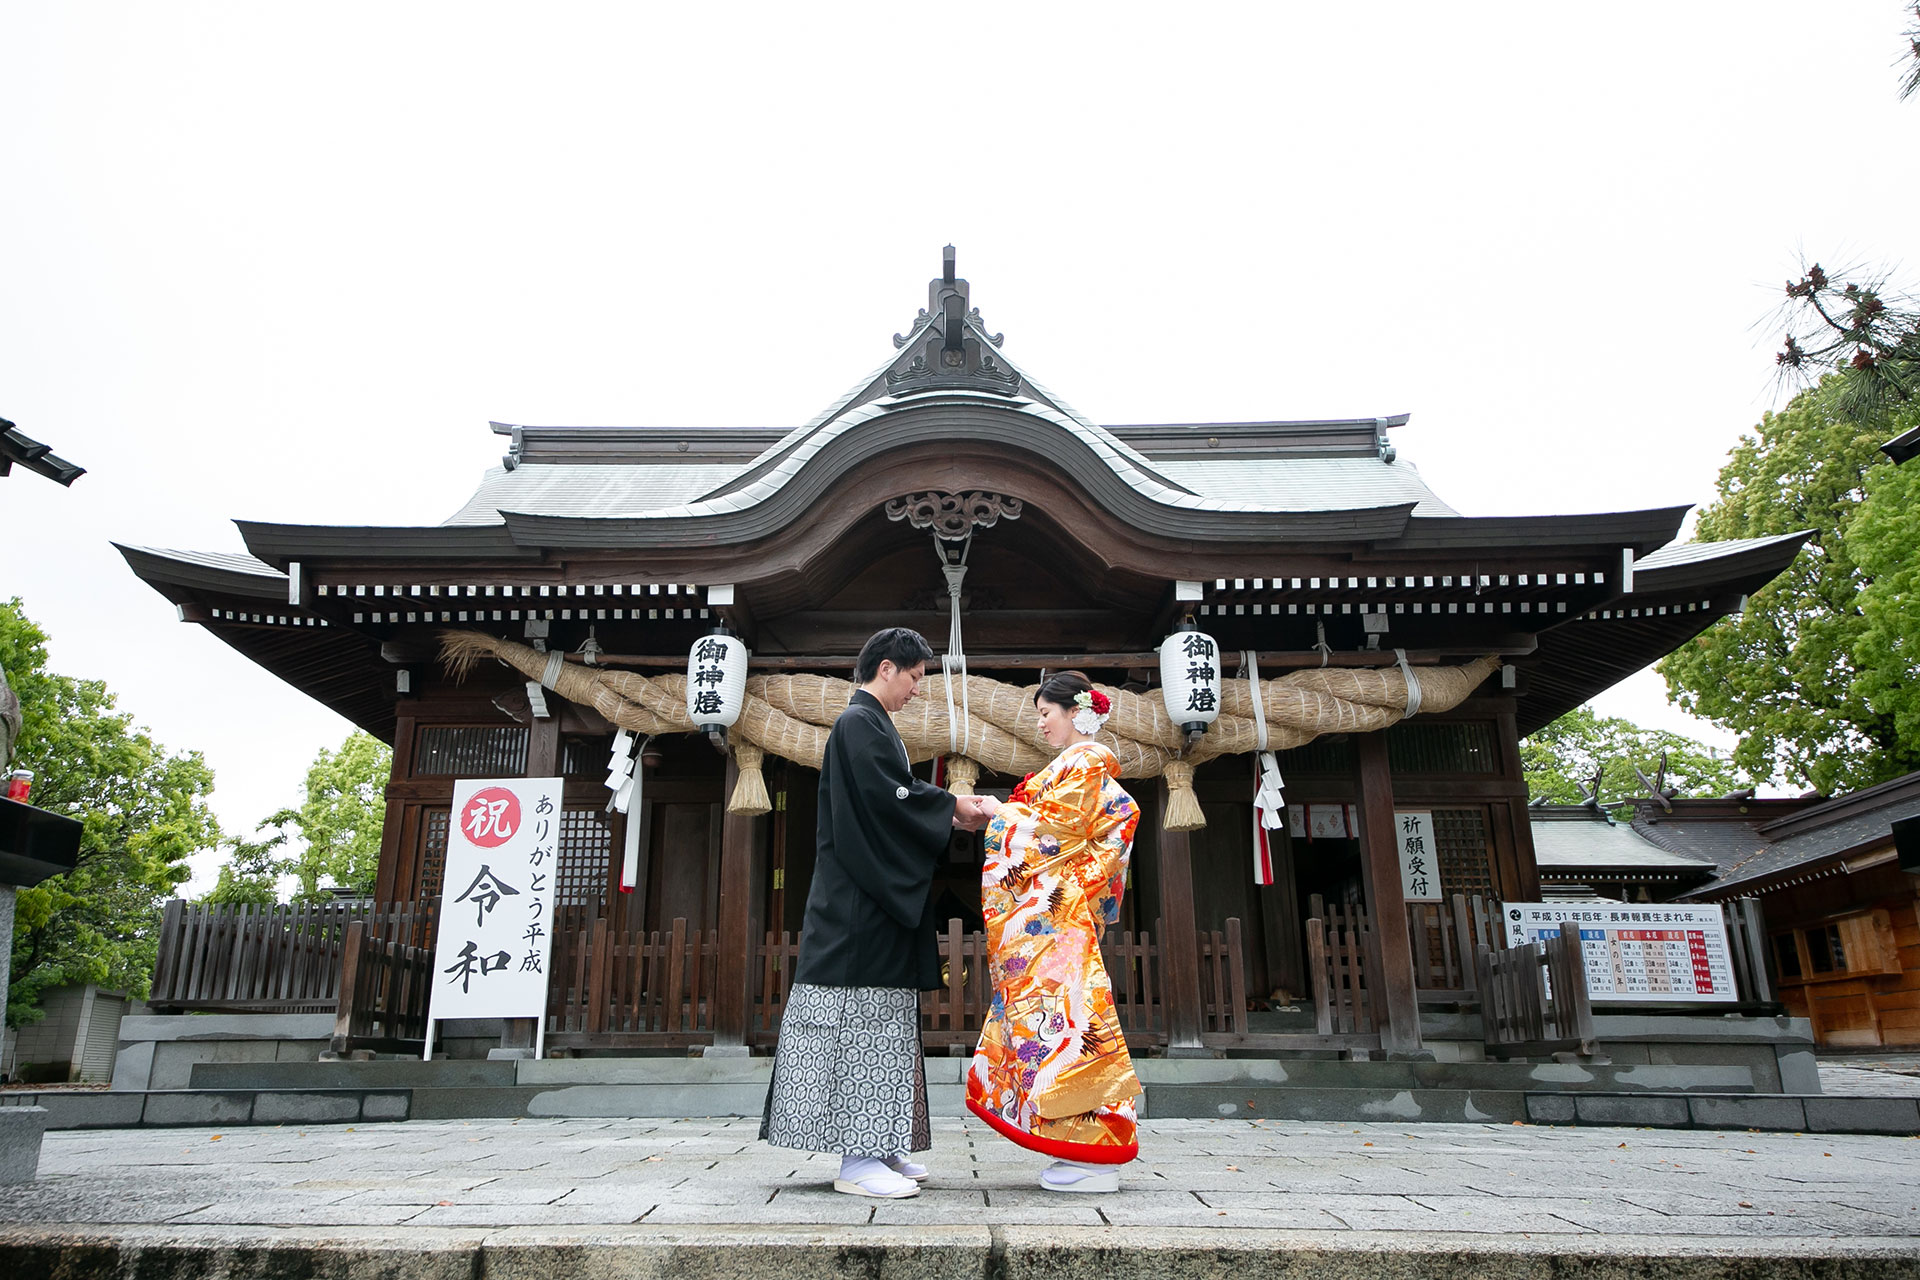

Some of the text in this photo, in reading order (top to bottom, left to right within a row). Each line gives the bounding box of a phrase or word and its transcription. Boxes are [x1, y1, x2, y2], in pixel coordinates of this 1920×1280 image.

[693, 638, 728, 715] 御神燈
[1182, 635, 1216, 712] 御神燈
[466, 798, 512, 839] 祝
[1402, 815, 1429, 897] 祈願受付
[518, 794, 554, 974] ありがとう平成
[444, 864, 520, 994] 令和
[1610, 936, 1623, 987] 女の厄年
